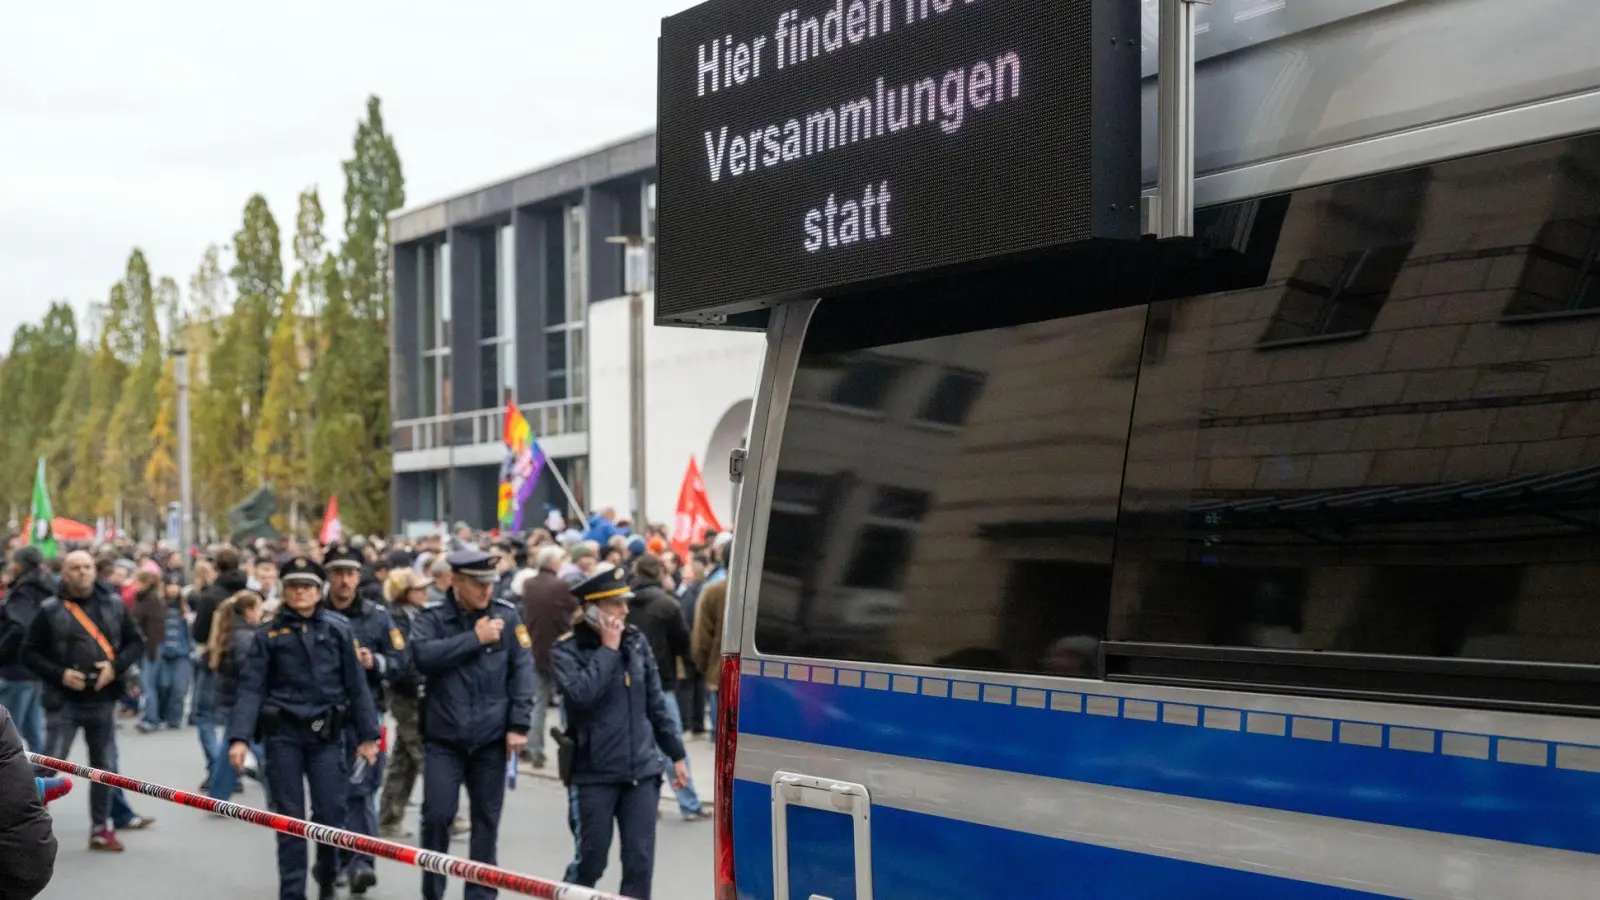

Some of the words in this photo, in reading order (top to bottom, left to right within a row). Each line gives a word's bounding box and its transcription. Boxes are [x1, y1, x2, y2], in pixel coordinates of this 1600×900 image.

[697, 35, 767, 97] Hier
[774, 0, 891, 70] finden
[704, 52, 1020, 182] Versammlungen
[804, 182, 891, 253] statt
